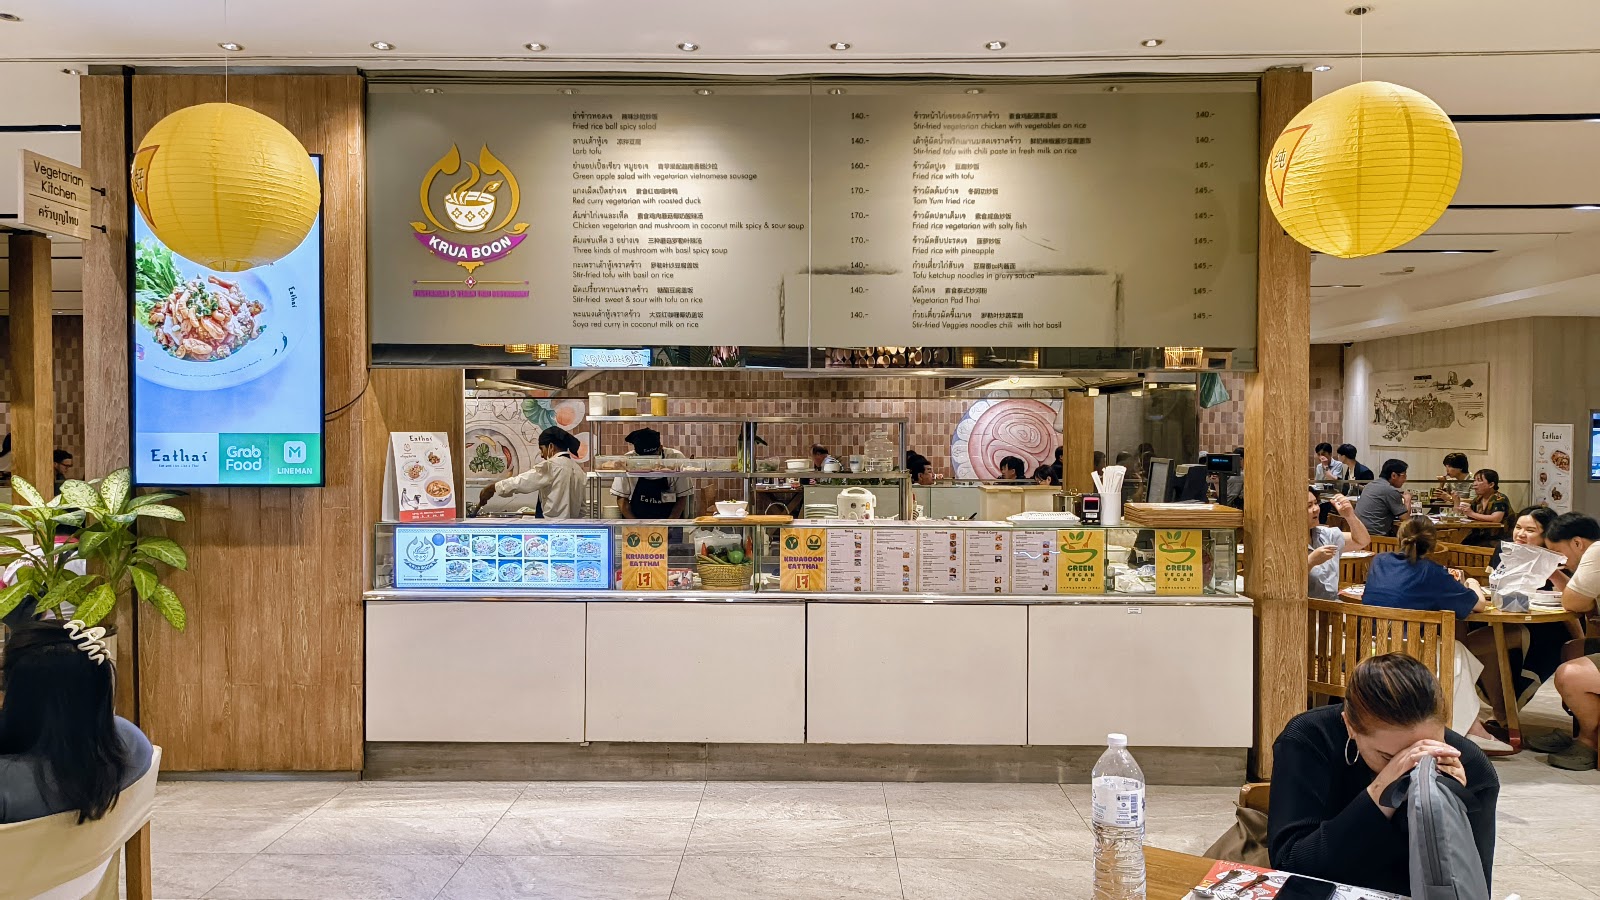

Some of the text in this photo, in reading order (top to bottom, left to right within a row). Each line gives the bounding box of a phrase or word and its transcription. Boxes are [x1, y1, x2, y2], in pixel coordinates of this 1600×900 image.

[1024, 122, 1061, 130] vegetables
[914, 146, 941, 154] Stir-fried
[34, 160, 84, 187] Vegetarian
[618, 172, 636, 180] salad
[931, 172, 943, 180] rice
[41, 180, 76, 201] Kitchen
[38, 205, 78, 226] ครัวบุญไทย
[429, 236, 512, 258] KRUA BOON
[928, 272, 955, 280] ketchup
[573, 320, 588, 328] Soya
[151, 449, 208, 461] Eathai
[226, 445, 261, 458] Grab
[226, 458, 262, 470] Food
